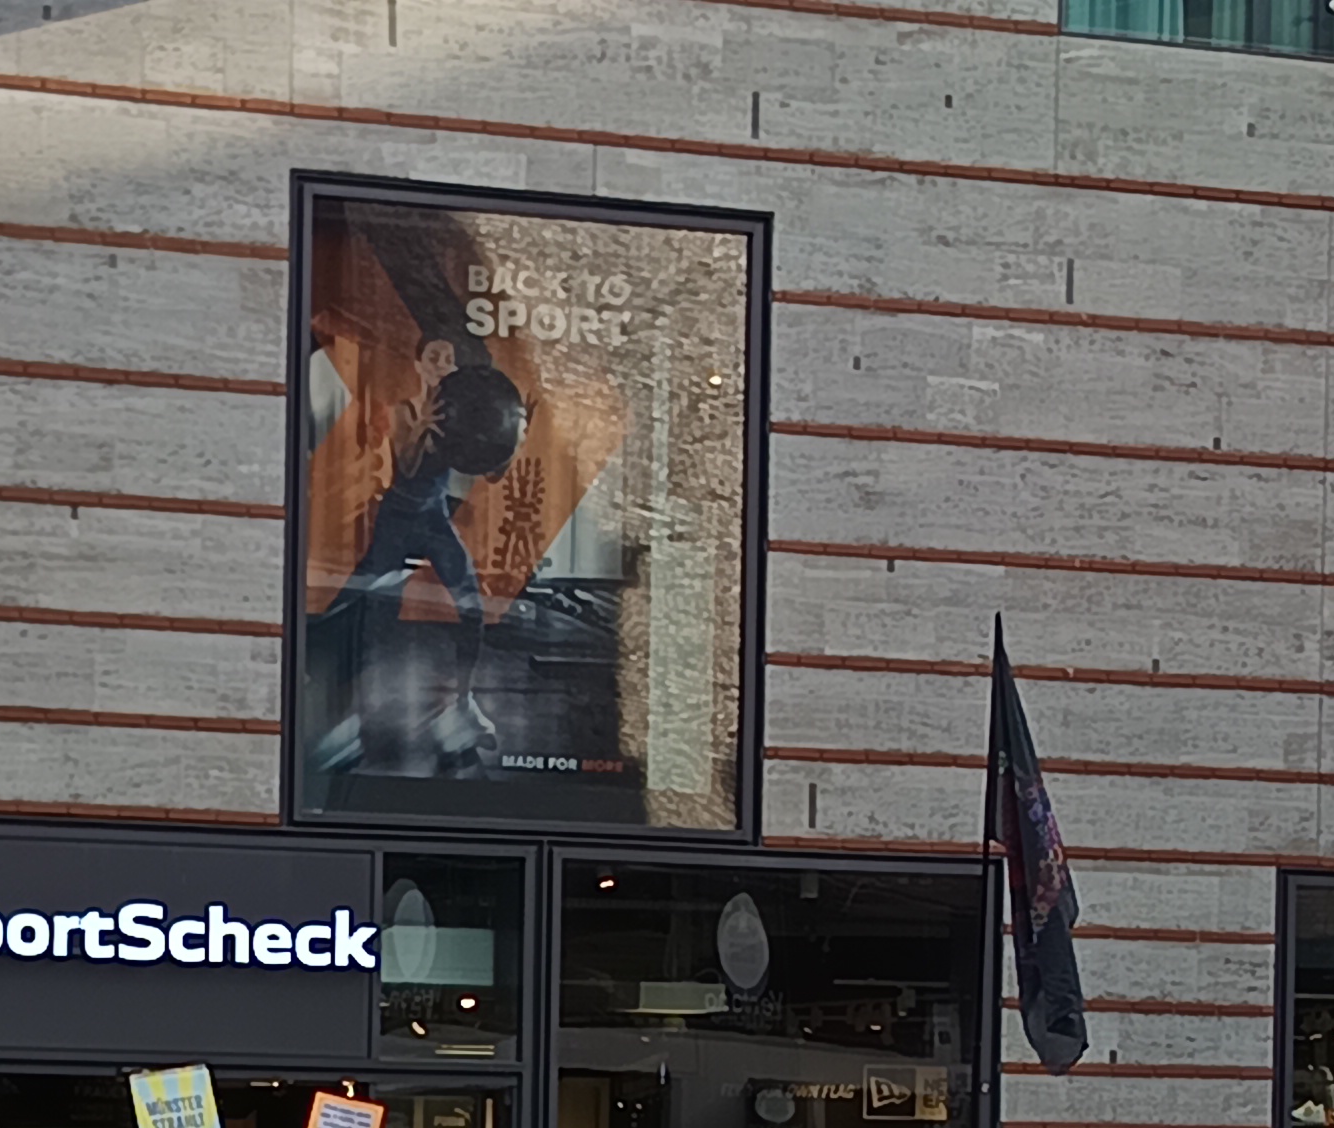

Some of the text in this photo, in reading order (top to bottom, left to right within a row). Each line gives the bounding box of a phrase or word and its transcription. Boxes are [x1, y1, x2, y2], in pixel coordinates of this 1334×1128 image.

[468, 265, 633, 306] BACK TO
[466, 298, 632, 346] SPORT
[548, 757, 577, 770] FOR
